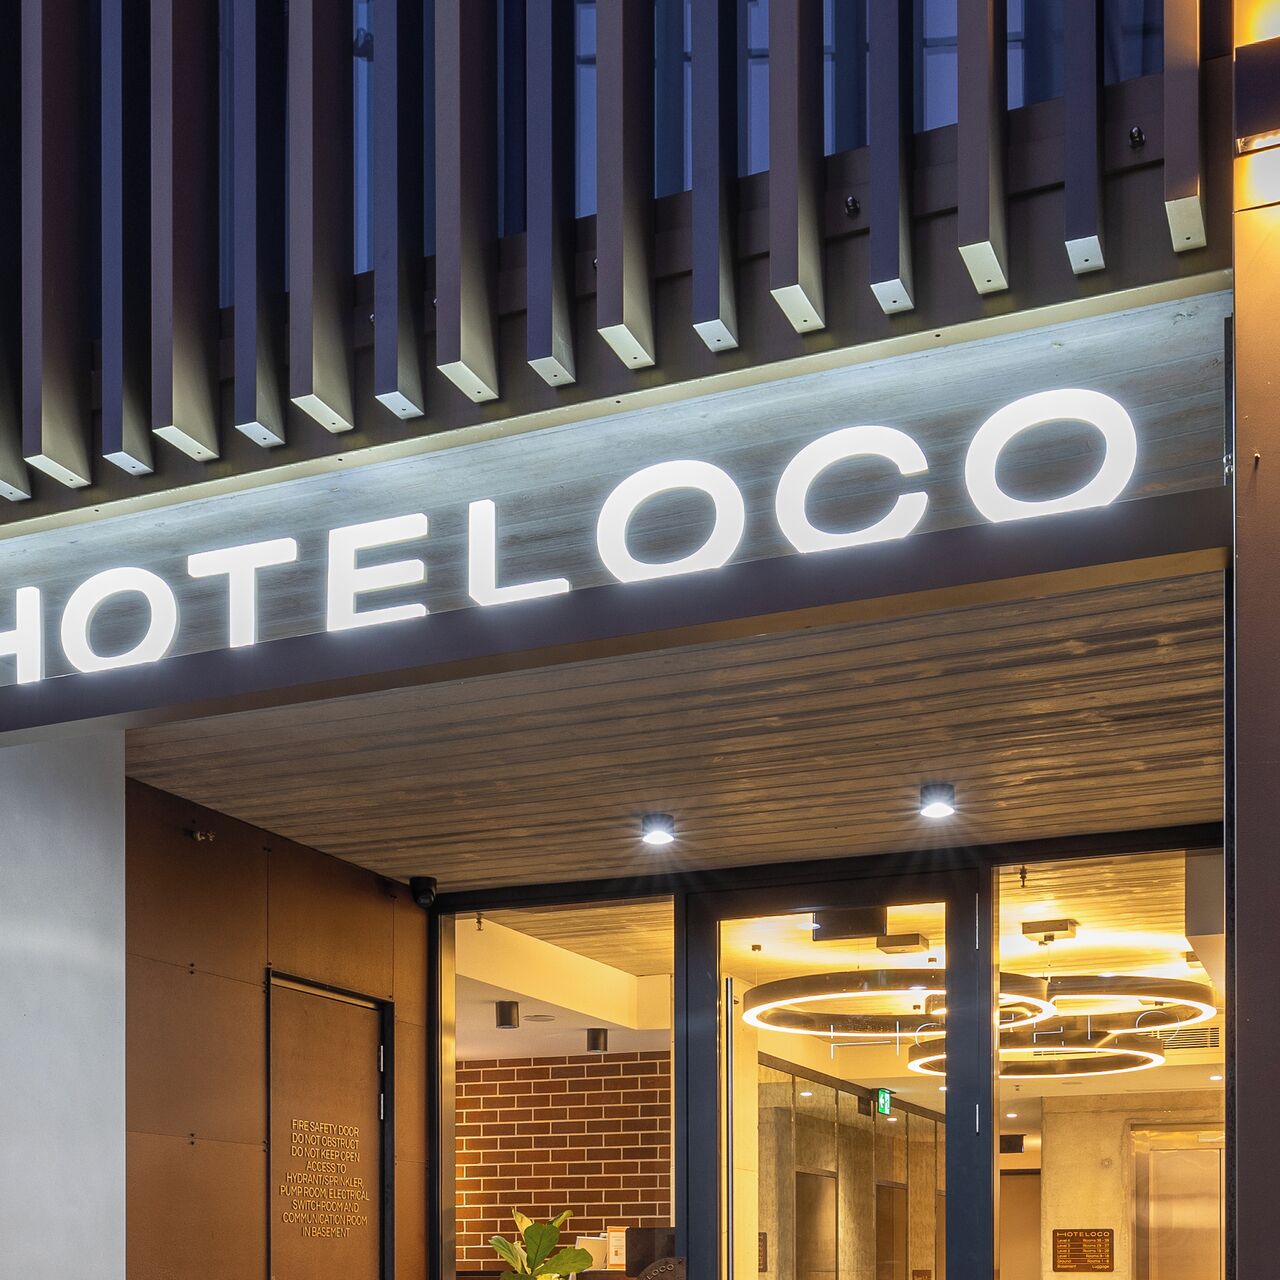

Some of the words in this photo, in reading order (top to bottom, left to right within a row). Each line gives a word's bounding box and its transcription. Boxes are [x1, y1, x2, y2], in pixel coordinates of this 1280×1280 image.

[292, 1119, 308, 1131] FIRE
[309, 1121, 337, 1134] SAFETY
[338, 1125, 360, 1137] DOOR
[292, 1132, 304, 1144] DO
[305, 1134, 320, 1146] NOT
[321, 1135, 359, 1150] OBSTRUCT
[291, 1145, 304, 1157] DO
[304, 1147, 320, 1158] NOT
[321, 1148, 340, 1160] KEEP
[340, 1151, 360, 1163] OPEN
[306, 1161, 336, 1173] ACCESS
[337, 1163, 347, 1174] TO
[280, 1185, 303, 1197] PUMP
[329, 1188, 370, 1201] ELECTRICAL
[344, 1202, 360, 1213] AND
[282, 1212, 346, 1225] COMMUNICATION
[346, 1215, 368, 1226] ROOM
[302, 1226, 311, 1237] IN
[312, 1226, 351, 1238] BASEMENT
